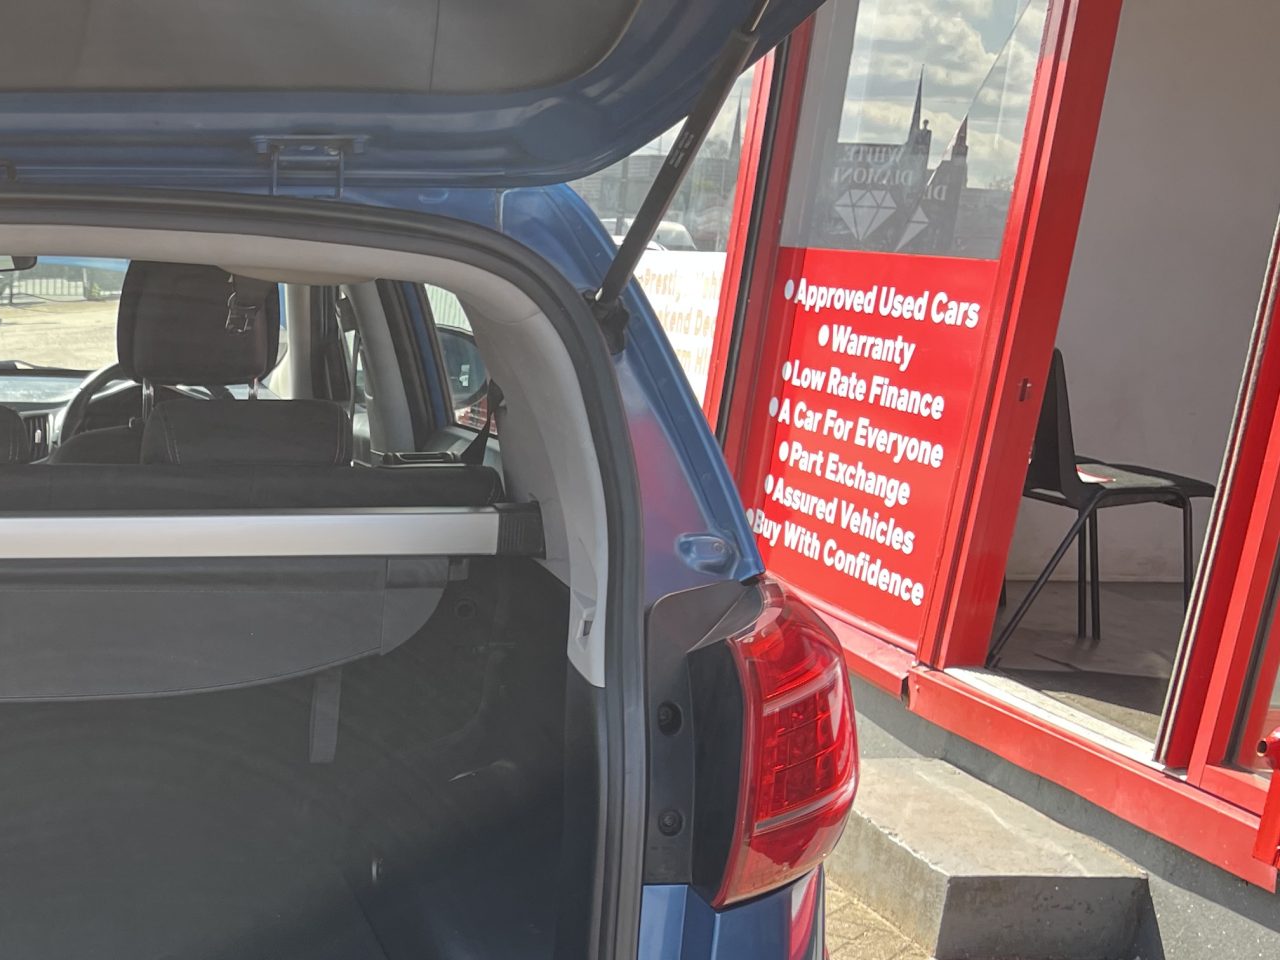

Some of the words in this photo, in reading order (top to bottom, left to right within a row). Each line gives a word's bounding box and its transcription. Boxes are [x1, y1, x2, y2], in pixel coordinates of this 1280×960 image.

[794, 278, 877, 314] Approved
[879, 285, 930, 321] Used
[930, 291, 981, 328] Cars
[831, 323, 916, 372] Warranty
[791, 359, 827, 391] Low
[826, 366, 867, 401] Rate
[868, 375, 945, 420] Finance
[778, 397, 791, 425] A
[793, 400, 823, 433] Car
[822, 408, 854, 442] For
[854, 417, 944, 468] Everyone
[789, 440, 824, 476] Part
[825, 452, 911, 508] Exchange
[772, 477, 839, 525] Assured
[840, 499, 916, 555] Vehicles
[752, 508, 782, 547] Buy
[783, 520, 822, 561] With
[823, 538, 925, 607] Confidence
